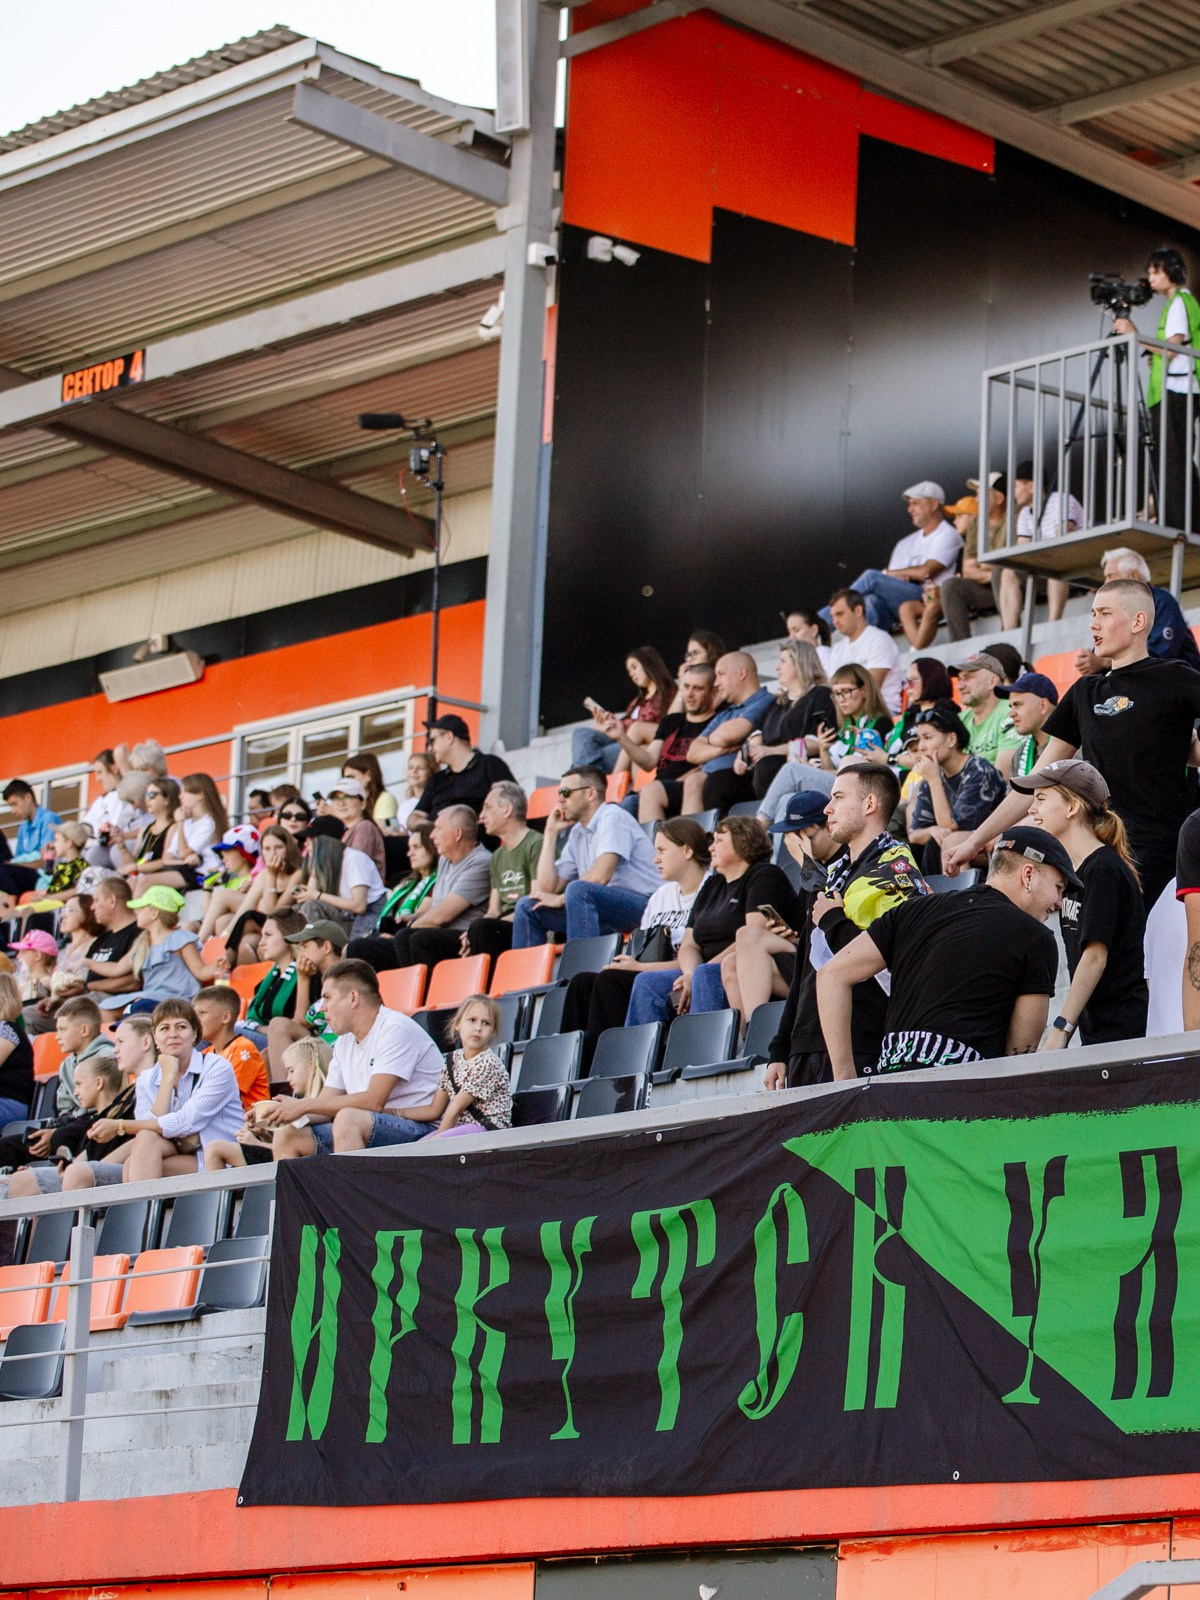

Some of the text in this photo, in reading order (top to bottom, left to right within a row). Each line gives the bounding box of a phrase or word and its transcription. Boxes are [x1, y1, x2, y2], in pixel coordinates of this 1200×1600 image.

[62, 350, 143, 402] СЕКТОР 4
[285, 1164, 908, 1444] ИРКУТСК
